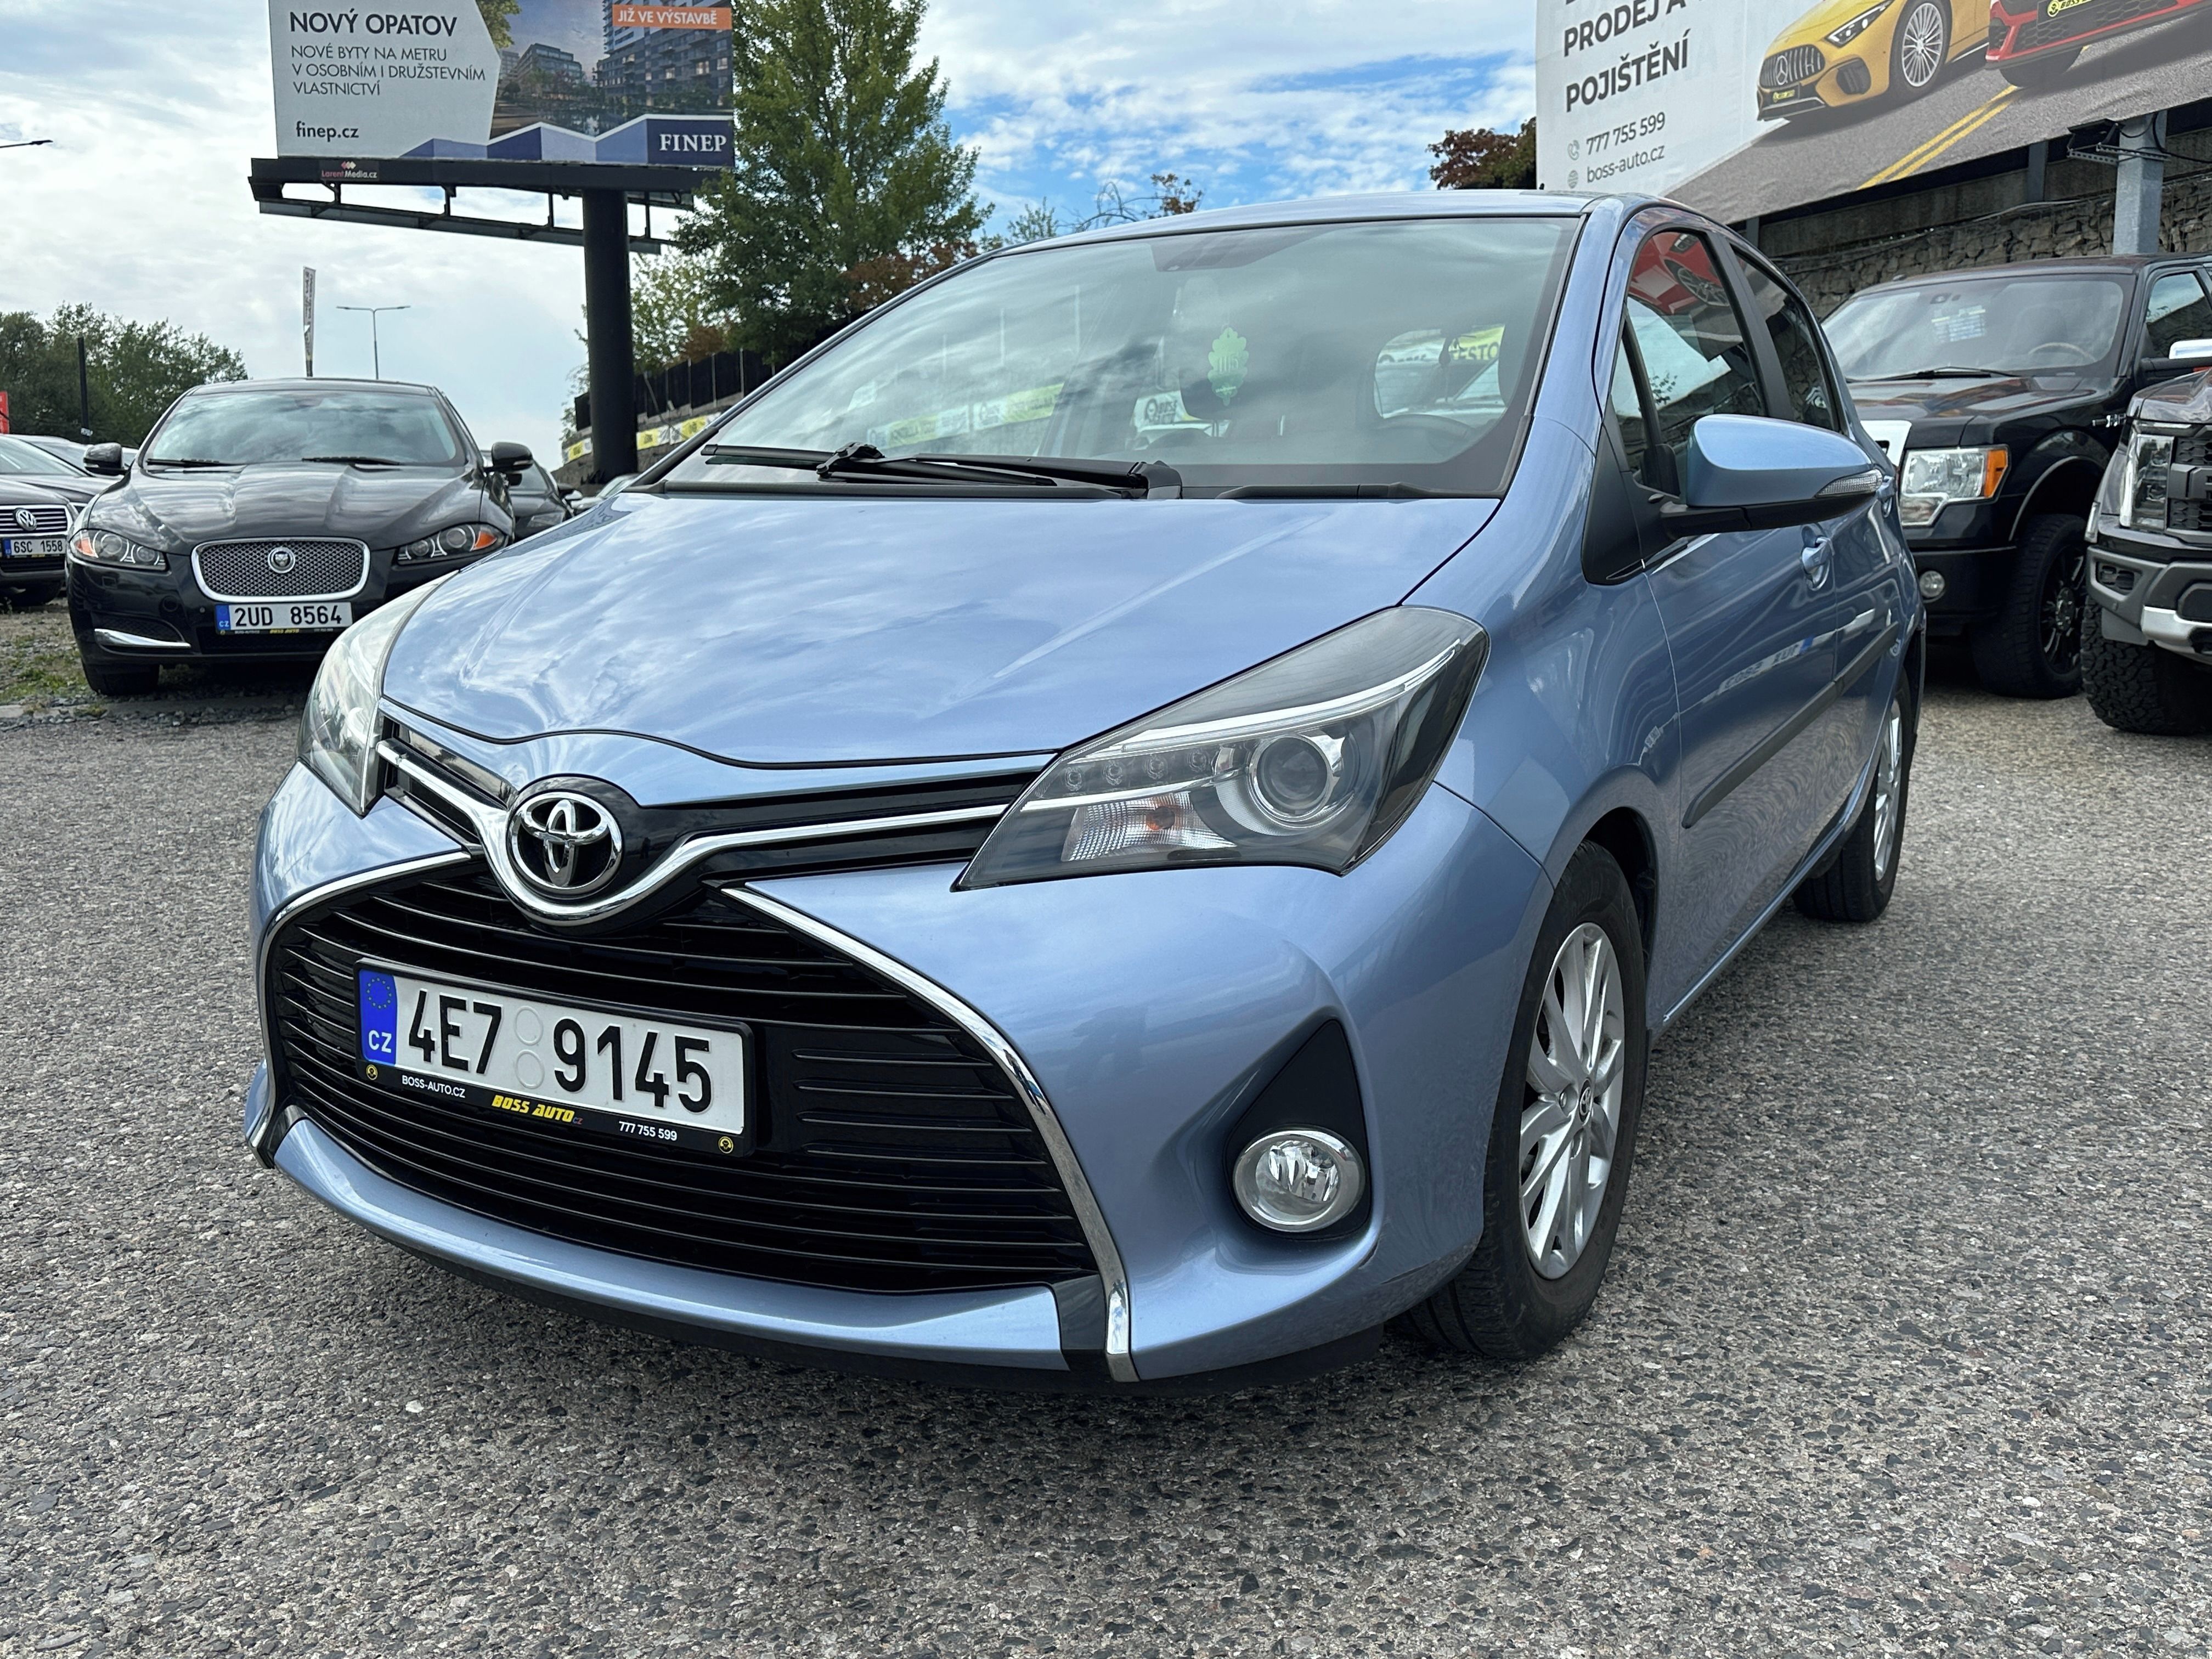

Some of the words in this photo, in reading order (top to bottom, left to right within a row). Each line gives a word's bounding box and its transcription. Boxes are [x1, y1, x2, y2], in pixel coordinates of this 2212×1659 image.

[290, 8, 358, 33] NOVÝ
[365, 14, 457, 36] OPATOV
[618, 7, 635, 22] JIŽ
[637, 11, 653, 23] VE
[656, 9, 717, 25] VÝSTAVBĚ
[1564, 0, 1658, 57] PRODEJ
[291, 43, 333, 58] NOVÉ
[338, 46, 369, 59] BYTY
[374, 47, 397, 60] NA
[401, 48, 447, 61] METRU
[292, 63, 302, 76] V
[306, 61, 376, 77] OSOBNÍM
[388, 63, 486, 81] DRUŽSTEVNÍM
[1566, 28, 1691, 112] POJIŠTĚNÍ
[293, 80, 380, 96] VLASTNICTVÍ
[296, 121, 359, 142] finep.cz
[1586, 131, 1610, 155] 777
[1613, 121, 1637, 146] 755
[1639, 111, 1665, 136] 599
[659, 133, 727, 152] FINEP
[1587, 145, 1664, 183] boss-auto.cz
[14, 541, 32, 553] 6SC
[41, 540, 63, 552] 1558
[234, 607, 273, 627] 2UD
[290, 605, 342, 625] 8564
[368, 1030, 392, 1053] CZ
[409, 989, 502, 1075] 4E7
[554, 1018, 712, 1114] 9145
[402, 1075, 466, 1098] BOSS-AUTO.CZ
[492, 1094, 530, 1114] BOSS
[618, 1121, 635, 1133] 777
[637, 1124, 656, 1138] 755
[658, 1128, 678, 1141] 599
